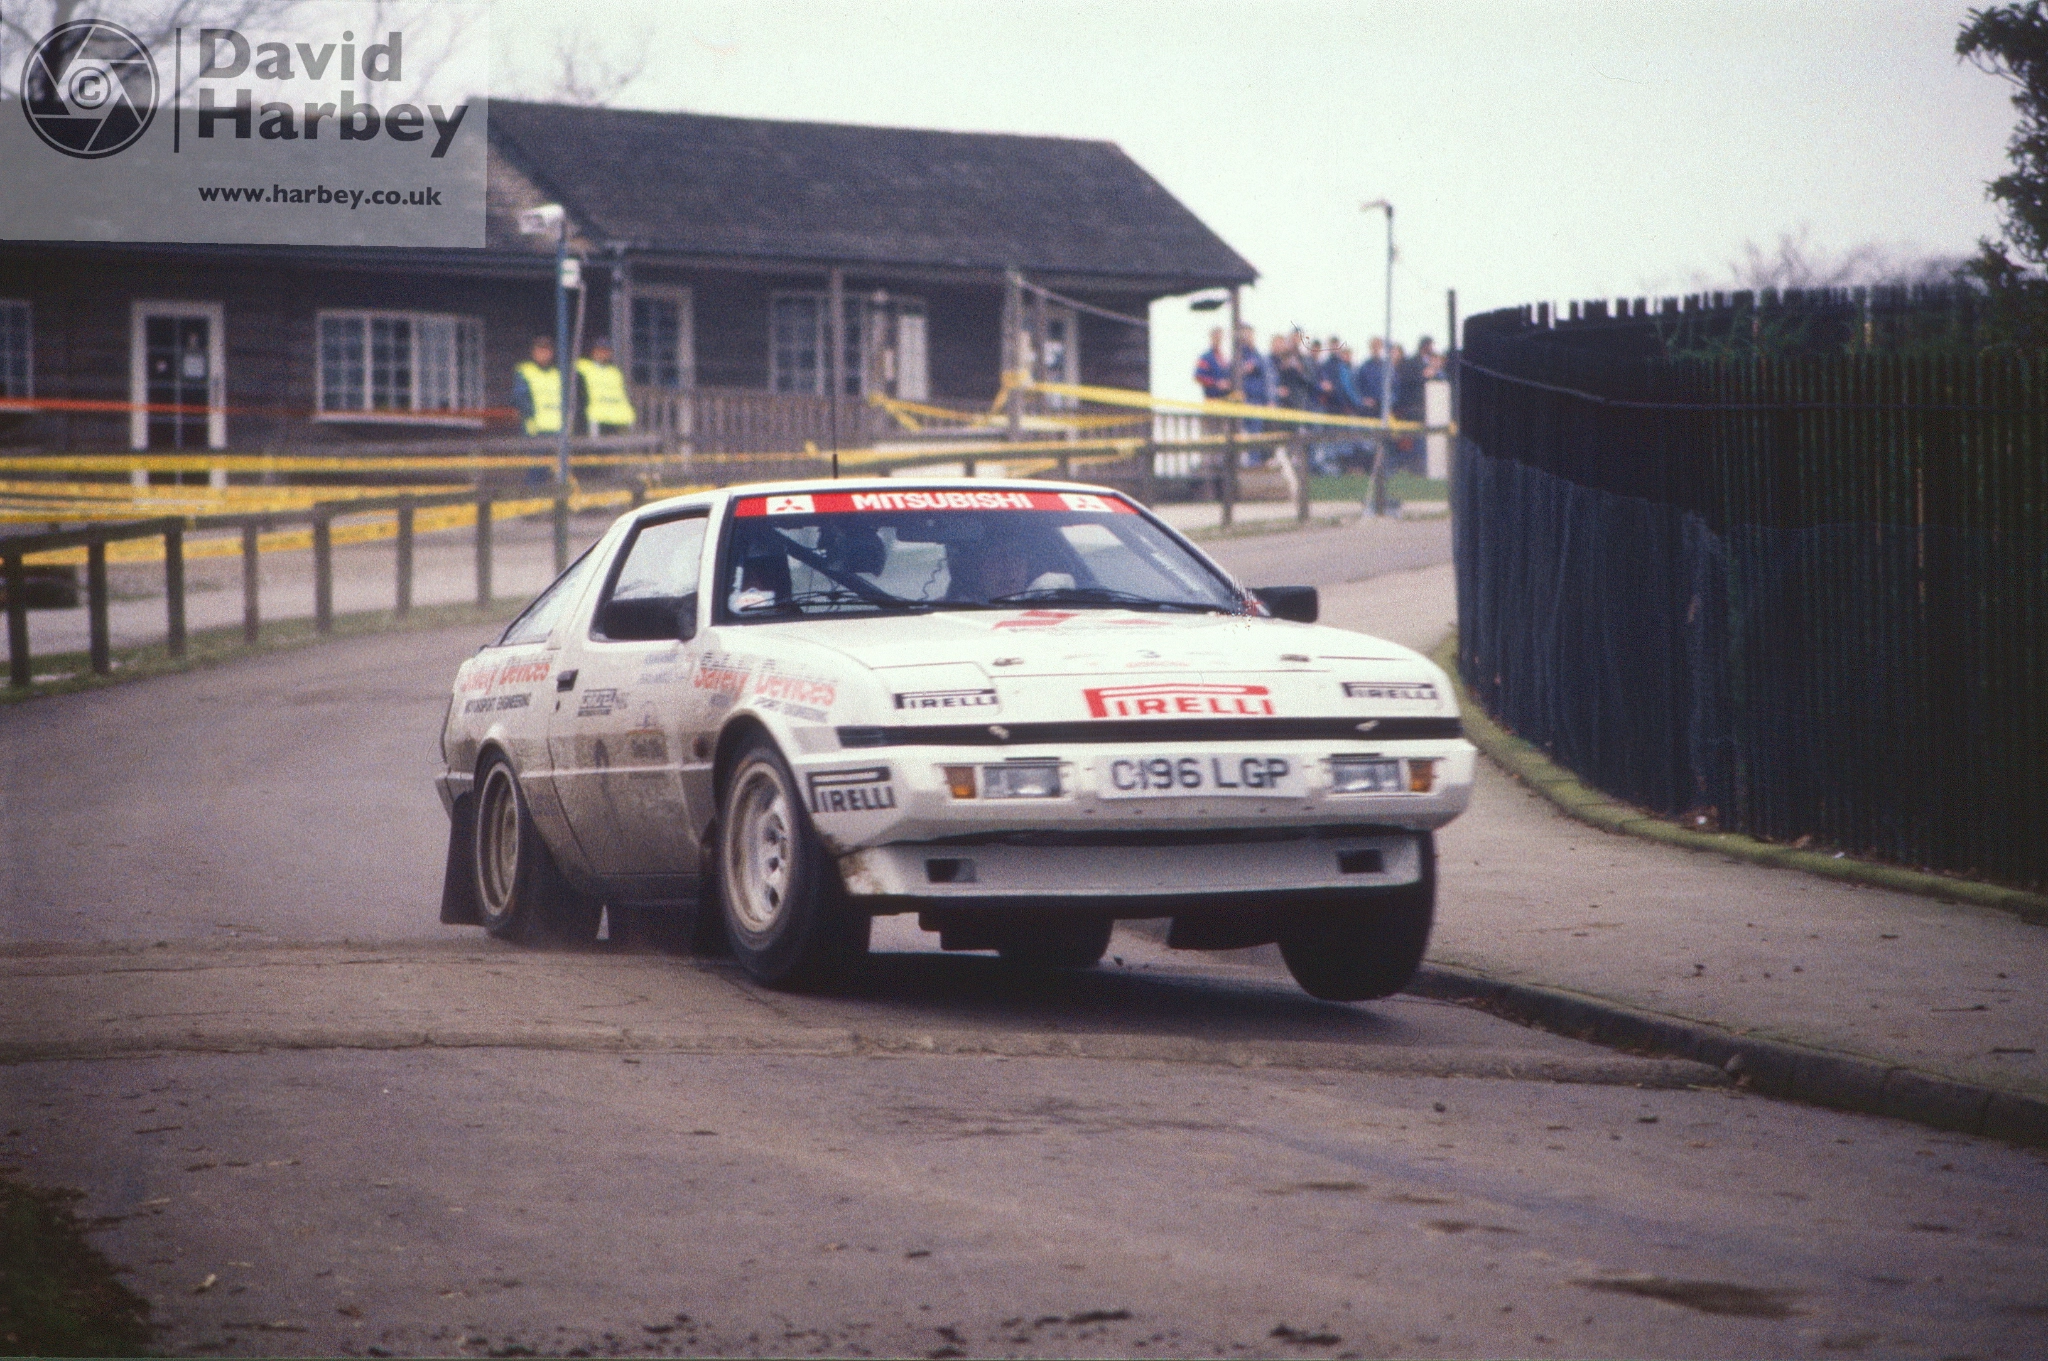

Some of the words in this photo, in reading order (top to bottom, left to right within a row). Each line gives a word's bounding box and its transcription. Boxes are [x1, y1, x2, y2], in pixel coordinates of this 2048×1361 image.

[851, 491, 1034, 511] MITSUBISHI
[894, 688, 998, 709] PIRELLI
[1083, 683, 1275, 718] PIRELLI
[1341, 681, 1438, 699] PIRELLI
[1111, 758, 1203, 791] C196
[1212, 757, 1288, 789] LGP
[806, 766, 896, 813] PIRELLI
